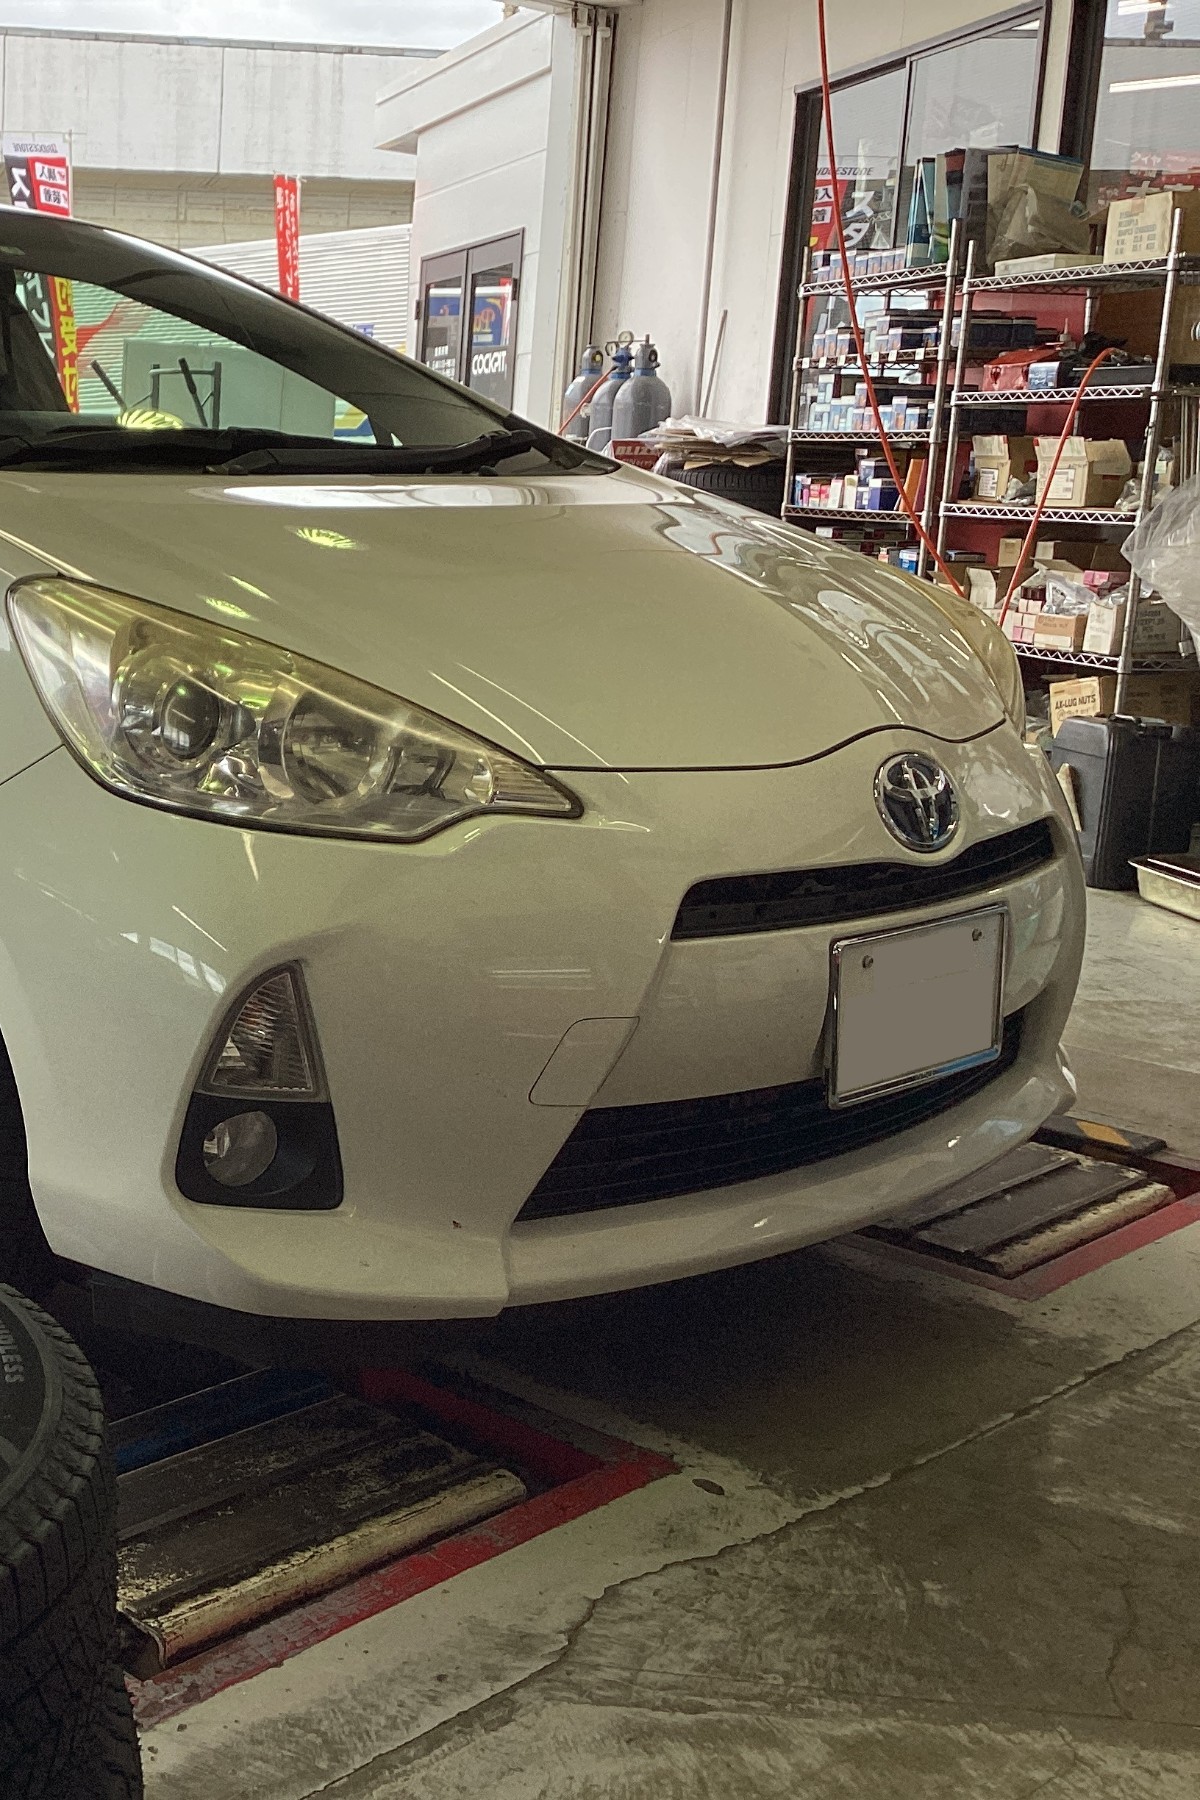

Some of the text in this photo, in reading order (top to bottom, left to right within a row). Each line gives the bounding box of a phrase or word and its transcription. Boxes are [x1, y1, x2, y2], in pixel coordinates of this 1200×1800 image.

[816, 166, 875, 176] IDESTONE
[815, 188, 832, 200] 入
[471, 350, 508, 375] COCKPIT
[1078, 693, 1096, 706] NUTS
